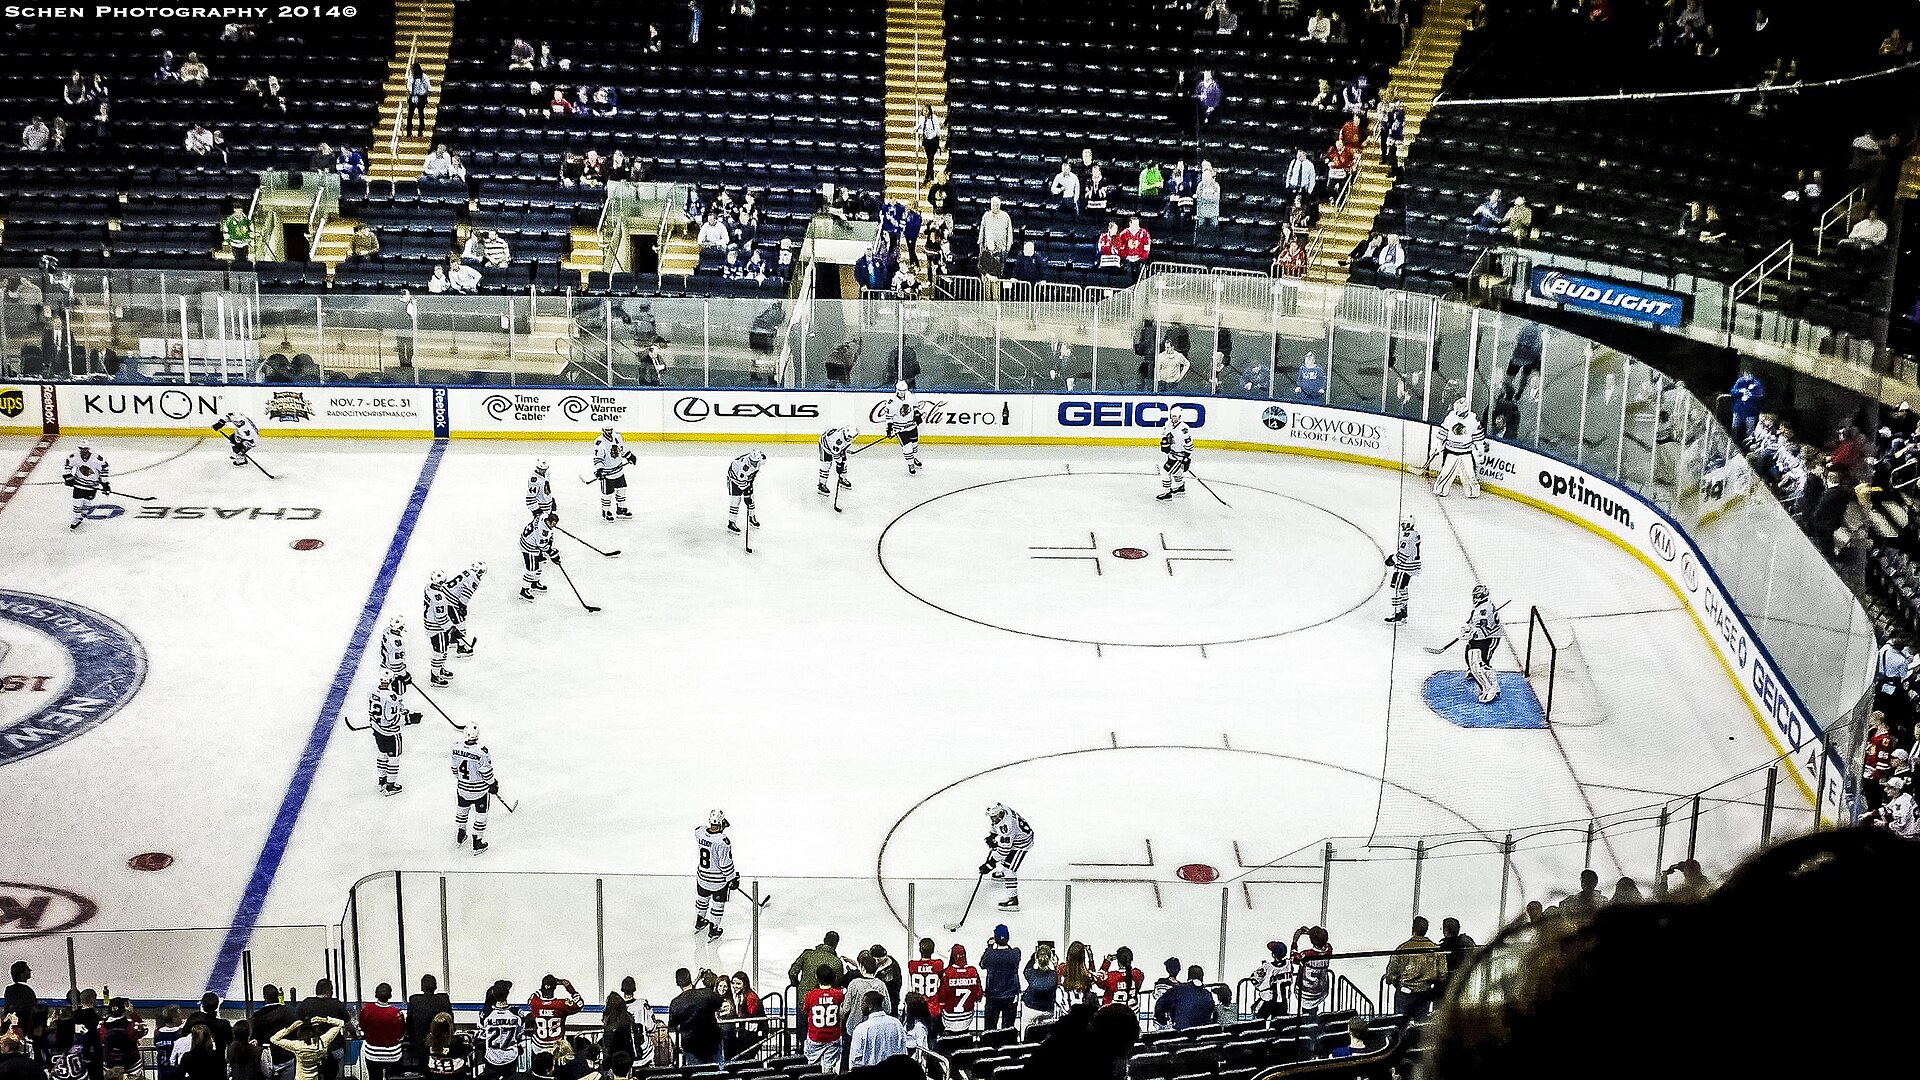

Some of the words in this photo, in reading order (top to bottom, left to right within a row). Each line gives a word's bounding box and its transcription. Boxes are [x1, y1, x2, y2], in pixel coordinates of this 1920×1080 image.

[1550, 278, 1601, 301] BUD
[1600, 289, 1673, 316] LIGHT
[43, 385, 55, 425] Reebok
[84, 389, 219, 420] KUMON
[330, 398, 355, 408] NOV.
[357, 398, 364, 408] 7
[373, 398, 397, 408] DEC.
[399, 398, 411, 408] 31
[435, 388, 446, 428] Reebok
[514, 394, 539, 403] Time
[514, 403, 551, 412] Warner
[590, 395, 616, 404] Time
[590, 404, 627, 413] Warner
[514, 412, 543, 421] Cable
[590, 413, 619, 422] Cable
[713, 403, 820, 419] LEXUS
[946, 411, 995, 426] zero
[1057, 401, 1206, 429] GEICO
[1291, 412, 1381, 440] FOXWOODS
[1290, 429, 1329, 442] RESORT
[1340, 436, 1380, 450] CASINO
[134, 505, 323, 521] CHASE
[1653, 528, 1673, 558] KIA
[1704, 587, 1738, 653] CHASE
[1753, 658, 1801, 754] GEICO
[4, 695, 109, 750] NEW
[458, 760, 470, 780] 4
[699, 847, 711, 869] 8
[911, 973, 940, 998] 88
[953, 988, 972, 1013] 7
[535, 1017, 562, 1039] 88
[811, 1004, 839, 1029] 88
[487, 1026, 517, 1050] 27
[51, 1052, 83, 1079] 30
